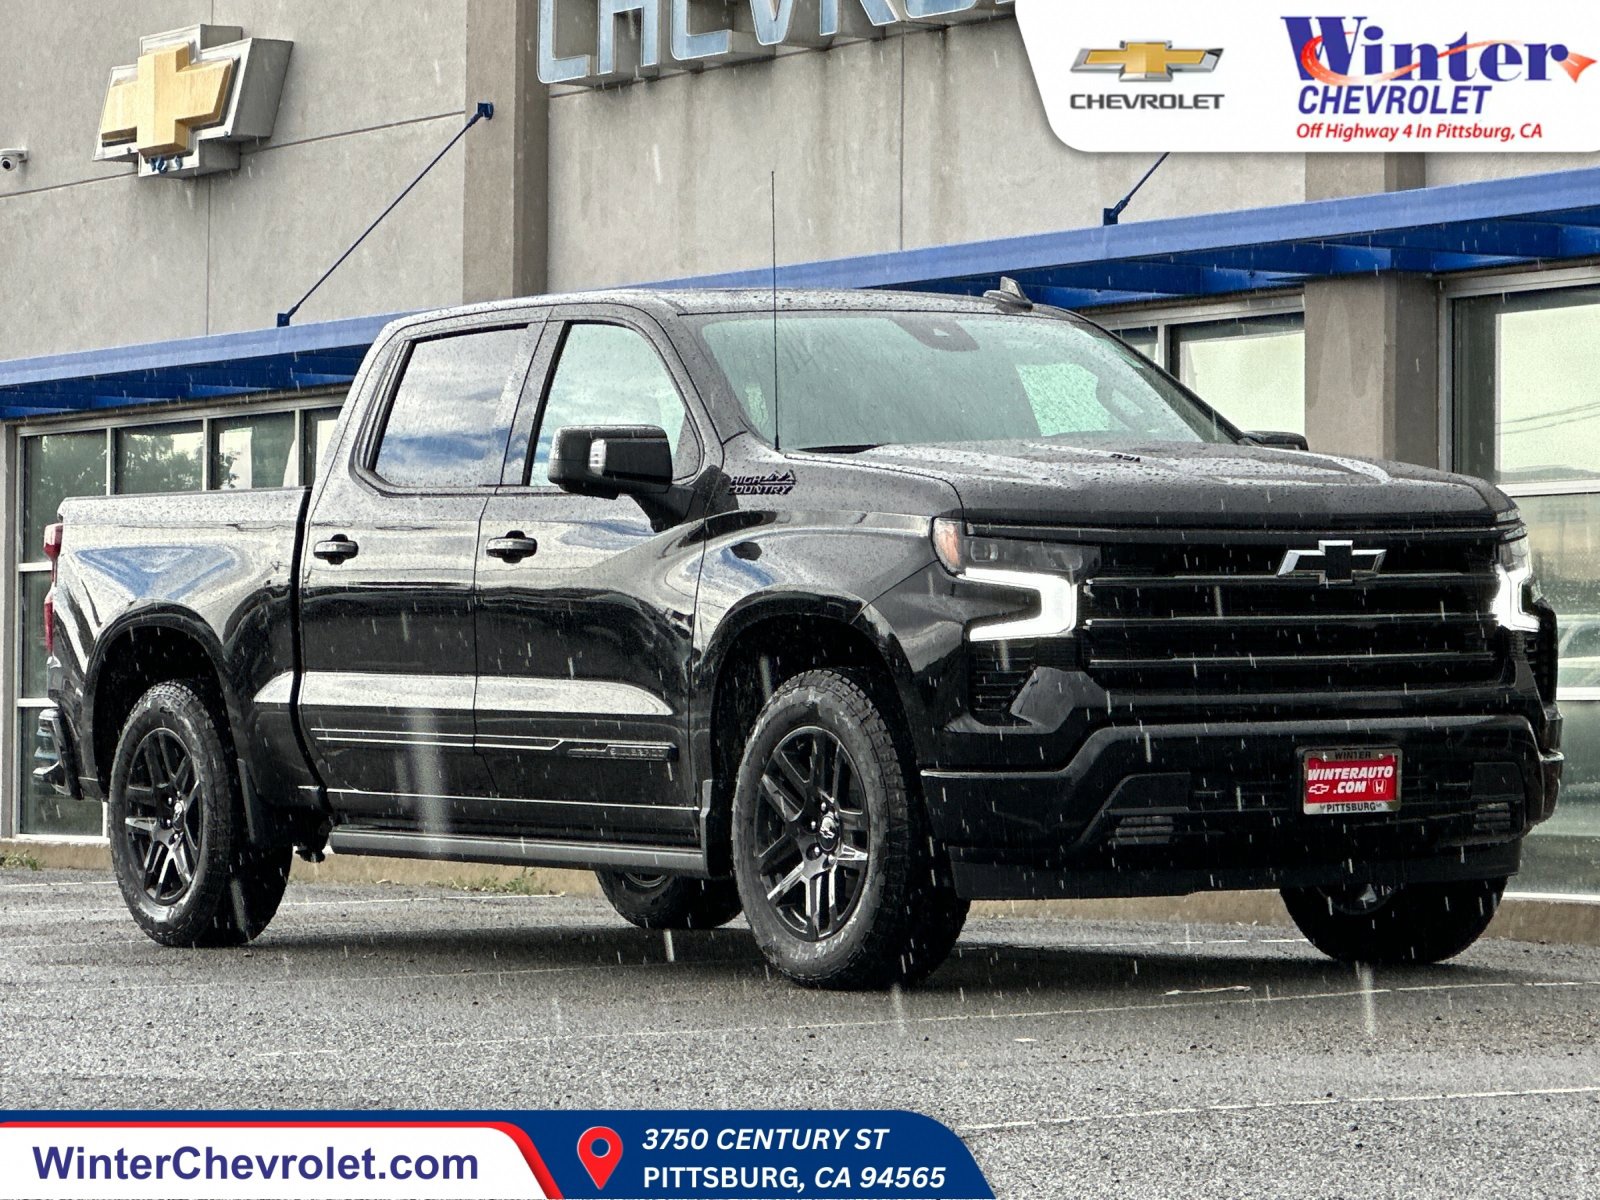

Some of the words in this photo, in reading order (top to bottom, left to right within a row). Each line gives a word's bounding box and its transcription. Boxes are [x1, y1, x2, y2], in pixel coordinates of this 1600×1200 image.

[1335, 751, 1371, 760] WINTER
[1308, 766, 1394, 781] WINTERAUTO
[1333, 781, 1367, 794] .COM
[1327, 802, 1376, 812] PITTSBURG
